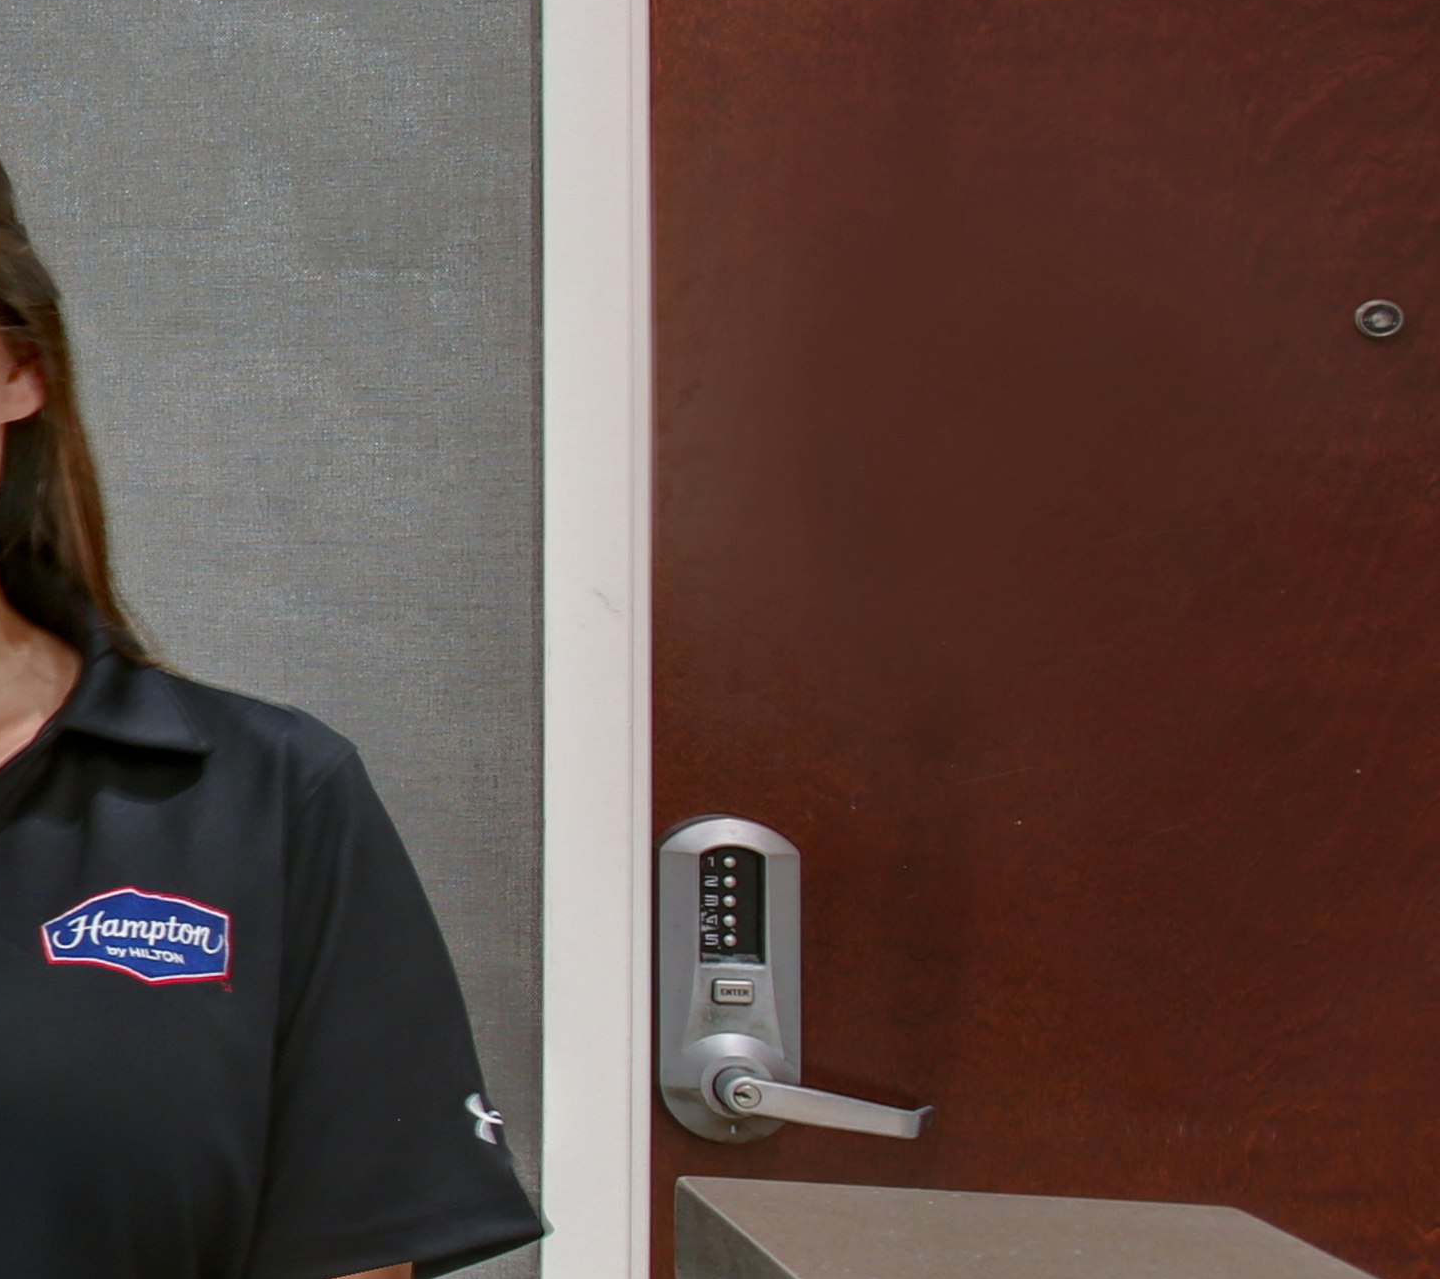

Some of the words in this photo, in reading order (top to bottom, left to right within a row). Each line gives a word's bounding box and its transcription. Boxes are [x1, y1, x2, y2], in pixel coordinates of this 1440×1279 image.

[707, 856, 715, 868] 1
[704, 875, 719, 887] 2
[704, 894, 719, 907] 3
[52, 910, 223, 955] Hampton
[704, 934, 719, 946] 5
[105, 945, 126, 958] by
[129, 946, 186, 965] HILTON
[720, 988, 749, 997] ENTER
